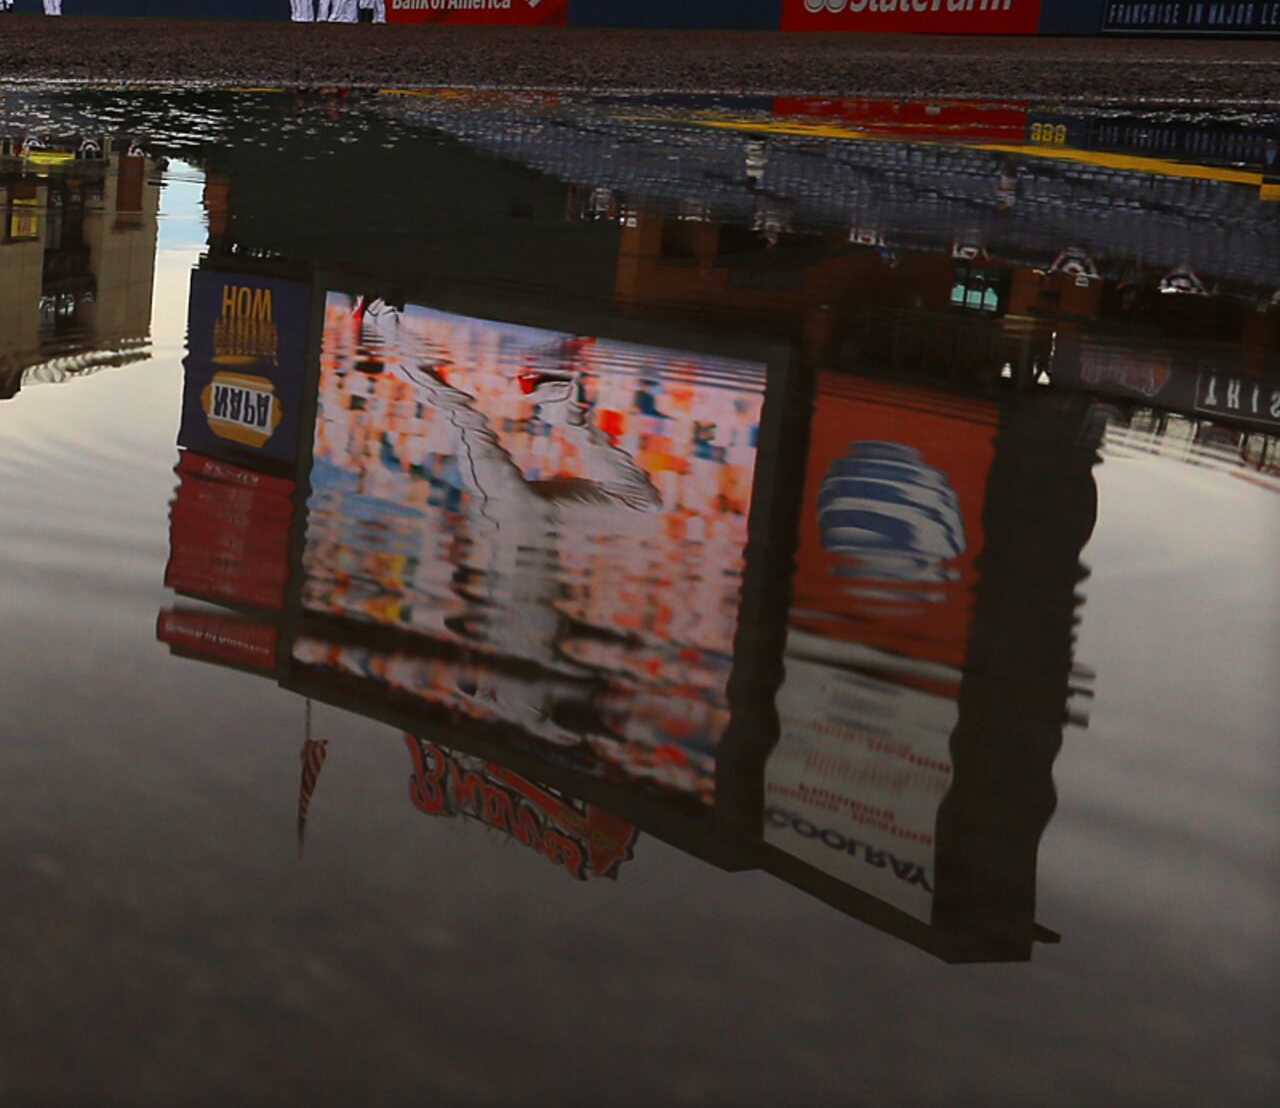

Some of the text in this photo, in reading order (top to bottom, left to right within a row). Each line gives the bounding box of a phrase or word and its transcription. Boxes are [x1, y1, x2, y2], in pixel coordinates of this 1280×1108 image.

[1108, 3, 1180, 25] FRANCHISE
[1186, 3, 1204, 25] IN
[1207, 3, 1254, 25] MAJOR
